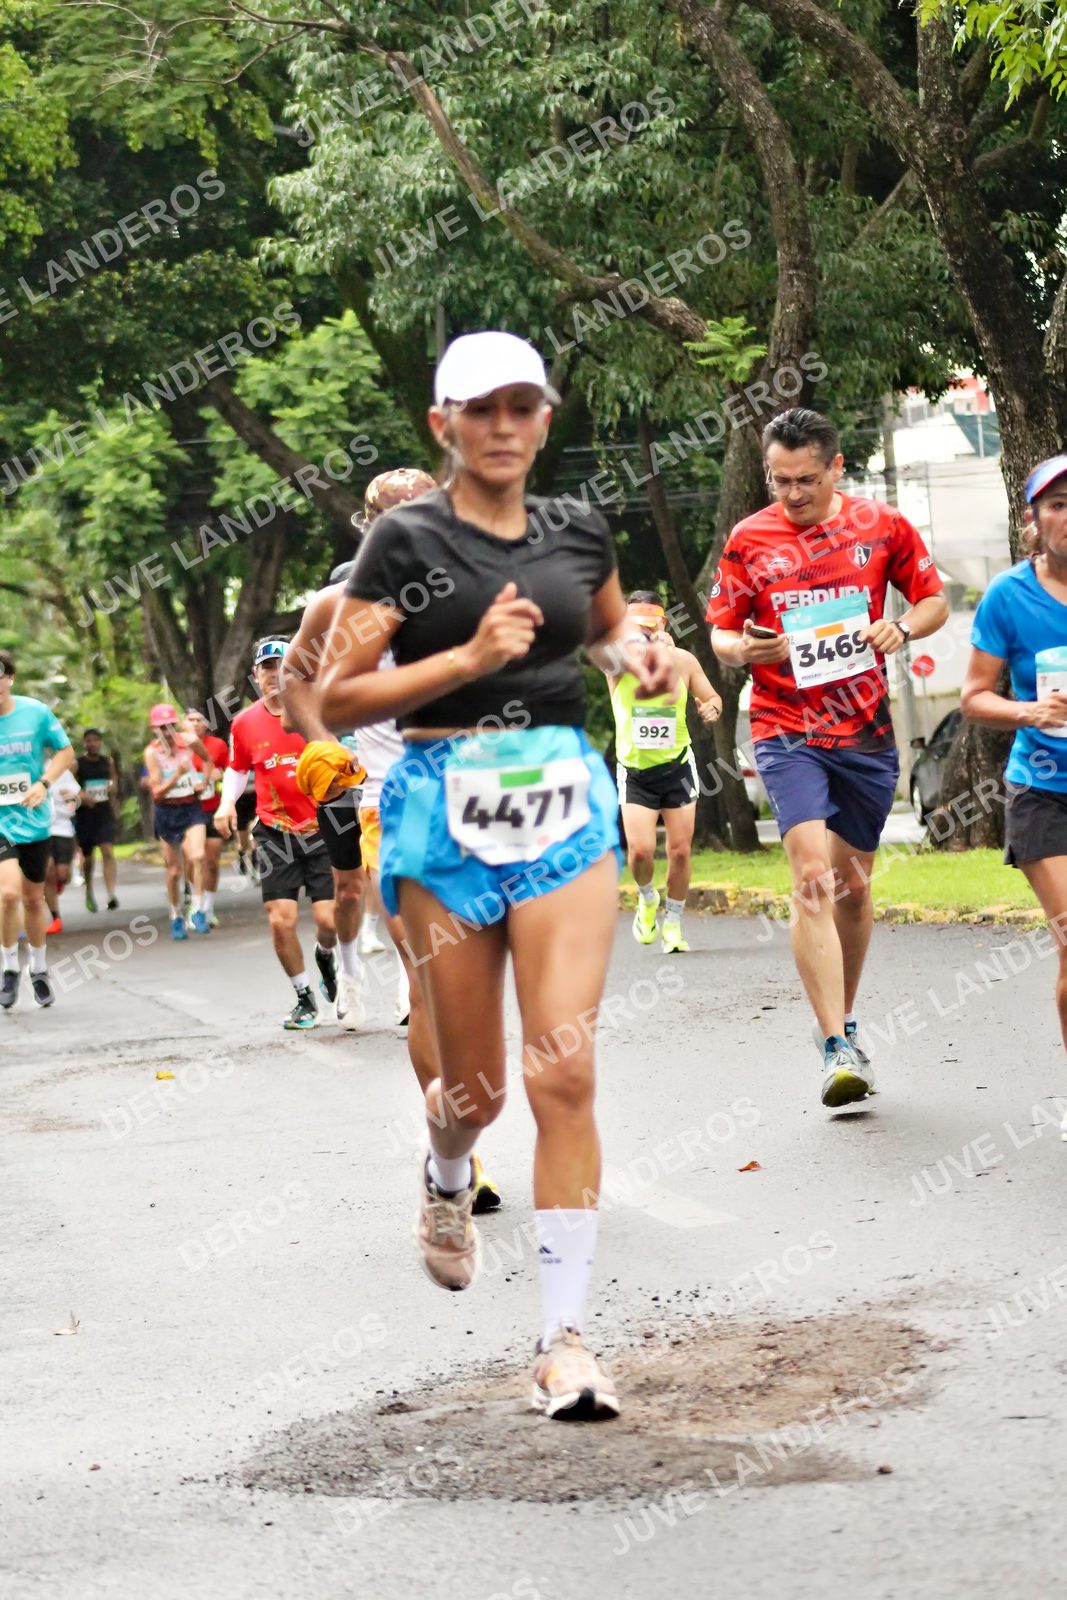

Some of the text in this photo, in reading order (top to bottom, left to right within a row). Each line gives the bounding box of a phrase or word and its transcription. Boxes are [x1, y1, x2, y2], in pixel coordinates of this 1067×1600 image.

[796, 630, 868, 668] 3469
[639, 725, 669, 738] 992
[462, 785, 574, 830] 4471
